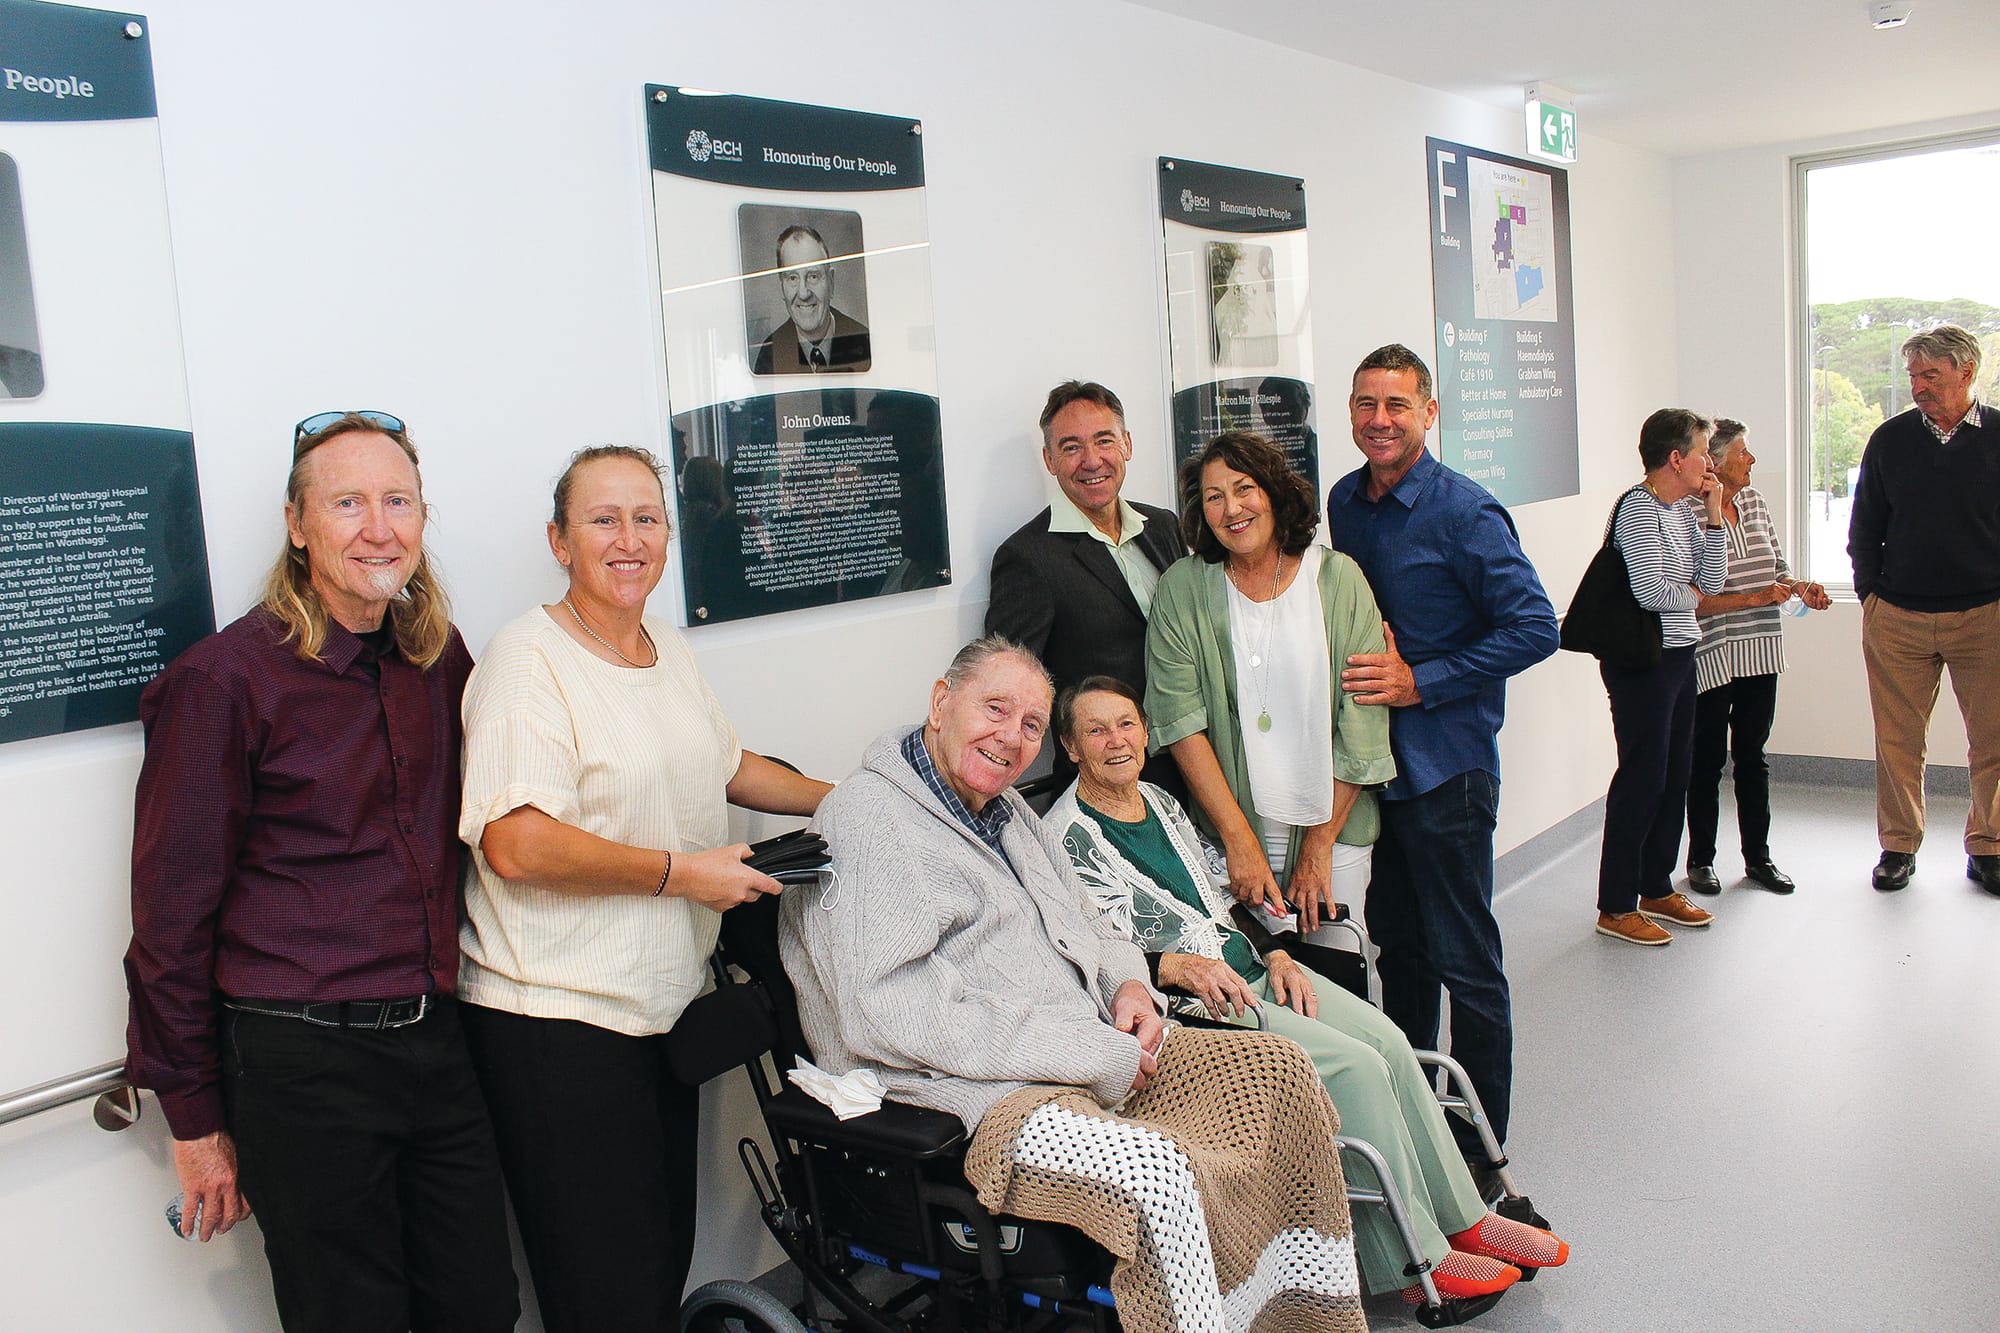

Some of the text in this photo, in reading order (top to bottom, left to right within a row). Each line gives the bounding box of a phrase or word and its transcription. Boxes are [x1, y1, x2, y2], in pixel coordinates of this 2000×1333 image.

[3, 68, 95, 99] People
[713, 140, 742, 156] BCH
[763, 148, 897, 176] Honouring Our People
[1437, 150, 1457, 233] F
[1194, 195, 1210, 208] BCH
[1220, 201, 1291, 221] Honouring Our People
[1517, 209, 1521, 218] E
[1440, 235, 1461, 250] Building
[1503, 232, 1508, 241] F
[1458, 329, 1488, 345] Building F
[1516, 330, 1543, 344] Building E
[1459, 350, 1490, 365] Pathology
[1517, 350, 1554, 364] Haemodialysis
[1460, 369, 1493, 381] Café 1910
[1518, 368, 1556, 382] Grabham Wing
[1215, 394, 1281, 407] Matron Mary Gillespie
[1461, 388, 1506, 401] Better at Home
[1519, 386, 1562, 400] Ambulatory Care
[782, 415, 851, 429] John Owens
[1462, 407, 1513, 424] Specialist Nursing
[1463, 425, 1513, 442] Consulting Suites
[1463, 448, 1493, 462] Pharmacy
[1490, 466, 1506, 480] Wing
[3, 486, 148, 506] Directors of Wonthaggi Hospital
[22, 505, 43, 515] Coal
[45, 504, 70, 513] Mine
[71, 501, 85, 511] for
[87, 501, 98, 510] 37
[99, 501, 126, 511] years.
[2, 512, 149, 532] to help support the family. After
[11, 531, 34, 541] 1922
[35, 531, 48, 539] he
[50, 526, 92, 539] migrated
[93, 526, 104, 534] to
[106, 522, 146, 533] Australia,
[16, 535, 109, 551] home in Wonthaggi.
[0, 546, 146, 568] ember of the local branch of the
[26, 557, 144, 576] stand in the way of having
[751, 570, 774, 579] honorary
[761, 563, 778, 571] service
[7, 580, 20, 588] he
[21, 575, 57, 587] worked
[58, 574, 79, 584] very
[80, 570, 111, 581] closely
[112, 567, 132, 577] with
[133, 565, 154, 575] local
[28, 575, 158, 597] establishment of the ground-
[31, 584, 152, 607] residents had free universal
[22, 596, 154, 619] had used in the past. This was
[8, 617, 57, 630] Medibank
[57, 616, 68, 625] to
[70, 611, 112, 623] Australia.
[3, 619, 145, 647] the hospital and his lobbying of
[5, 646, 32, 657] made
[34, 645, 45, 653] to
[46, 639, 79, 651] extend
[80, 638, 95, 647] the
[96, 632, 132, 645] hospital
[133, 631, 143, 639] in
[144, 628, 167, 638] 1980.
[44, 653, 54, 662] in
[55, 650, 77, 660] 1982
[78, 647, 96, 657] and
[98, 646, 115, 654] was
[117, 640, 147, 652] named
[148, 639, 158, 647] in
[9, 664, 64, 677] Committee,
[65, 658, 100, 669] William
[101, 655, 127, 664] Sharp
[128, 650, 160, 660] Stirton.
[37, 680, 53, 689] the
[54, 676, 75, 686] lives
[76, 672, 86, 683] of
[88, 669, 126, 681] workers.
[126, 666, 140, 674] He
[141, 662, 158, 673] had
[34, 689, 45, 700] of
[47, 684, 87, 697] excellent
[88, 679, 117, 691] health
[118, 677, 138, 686] care
